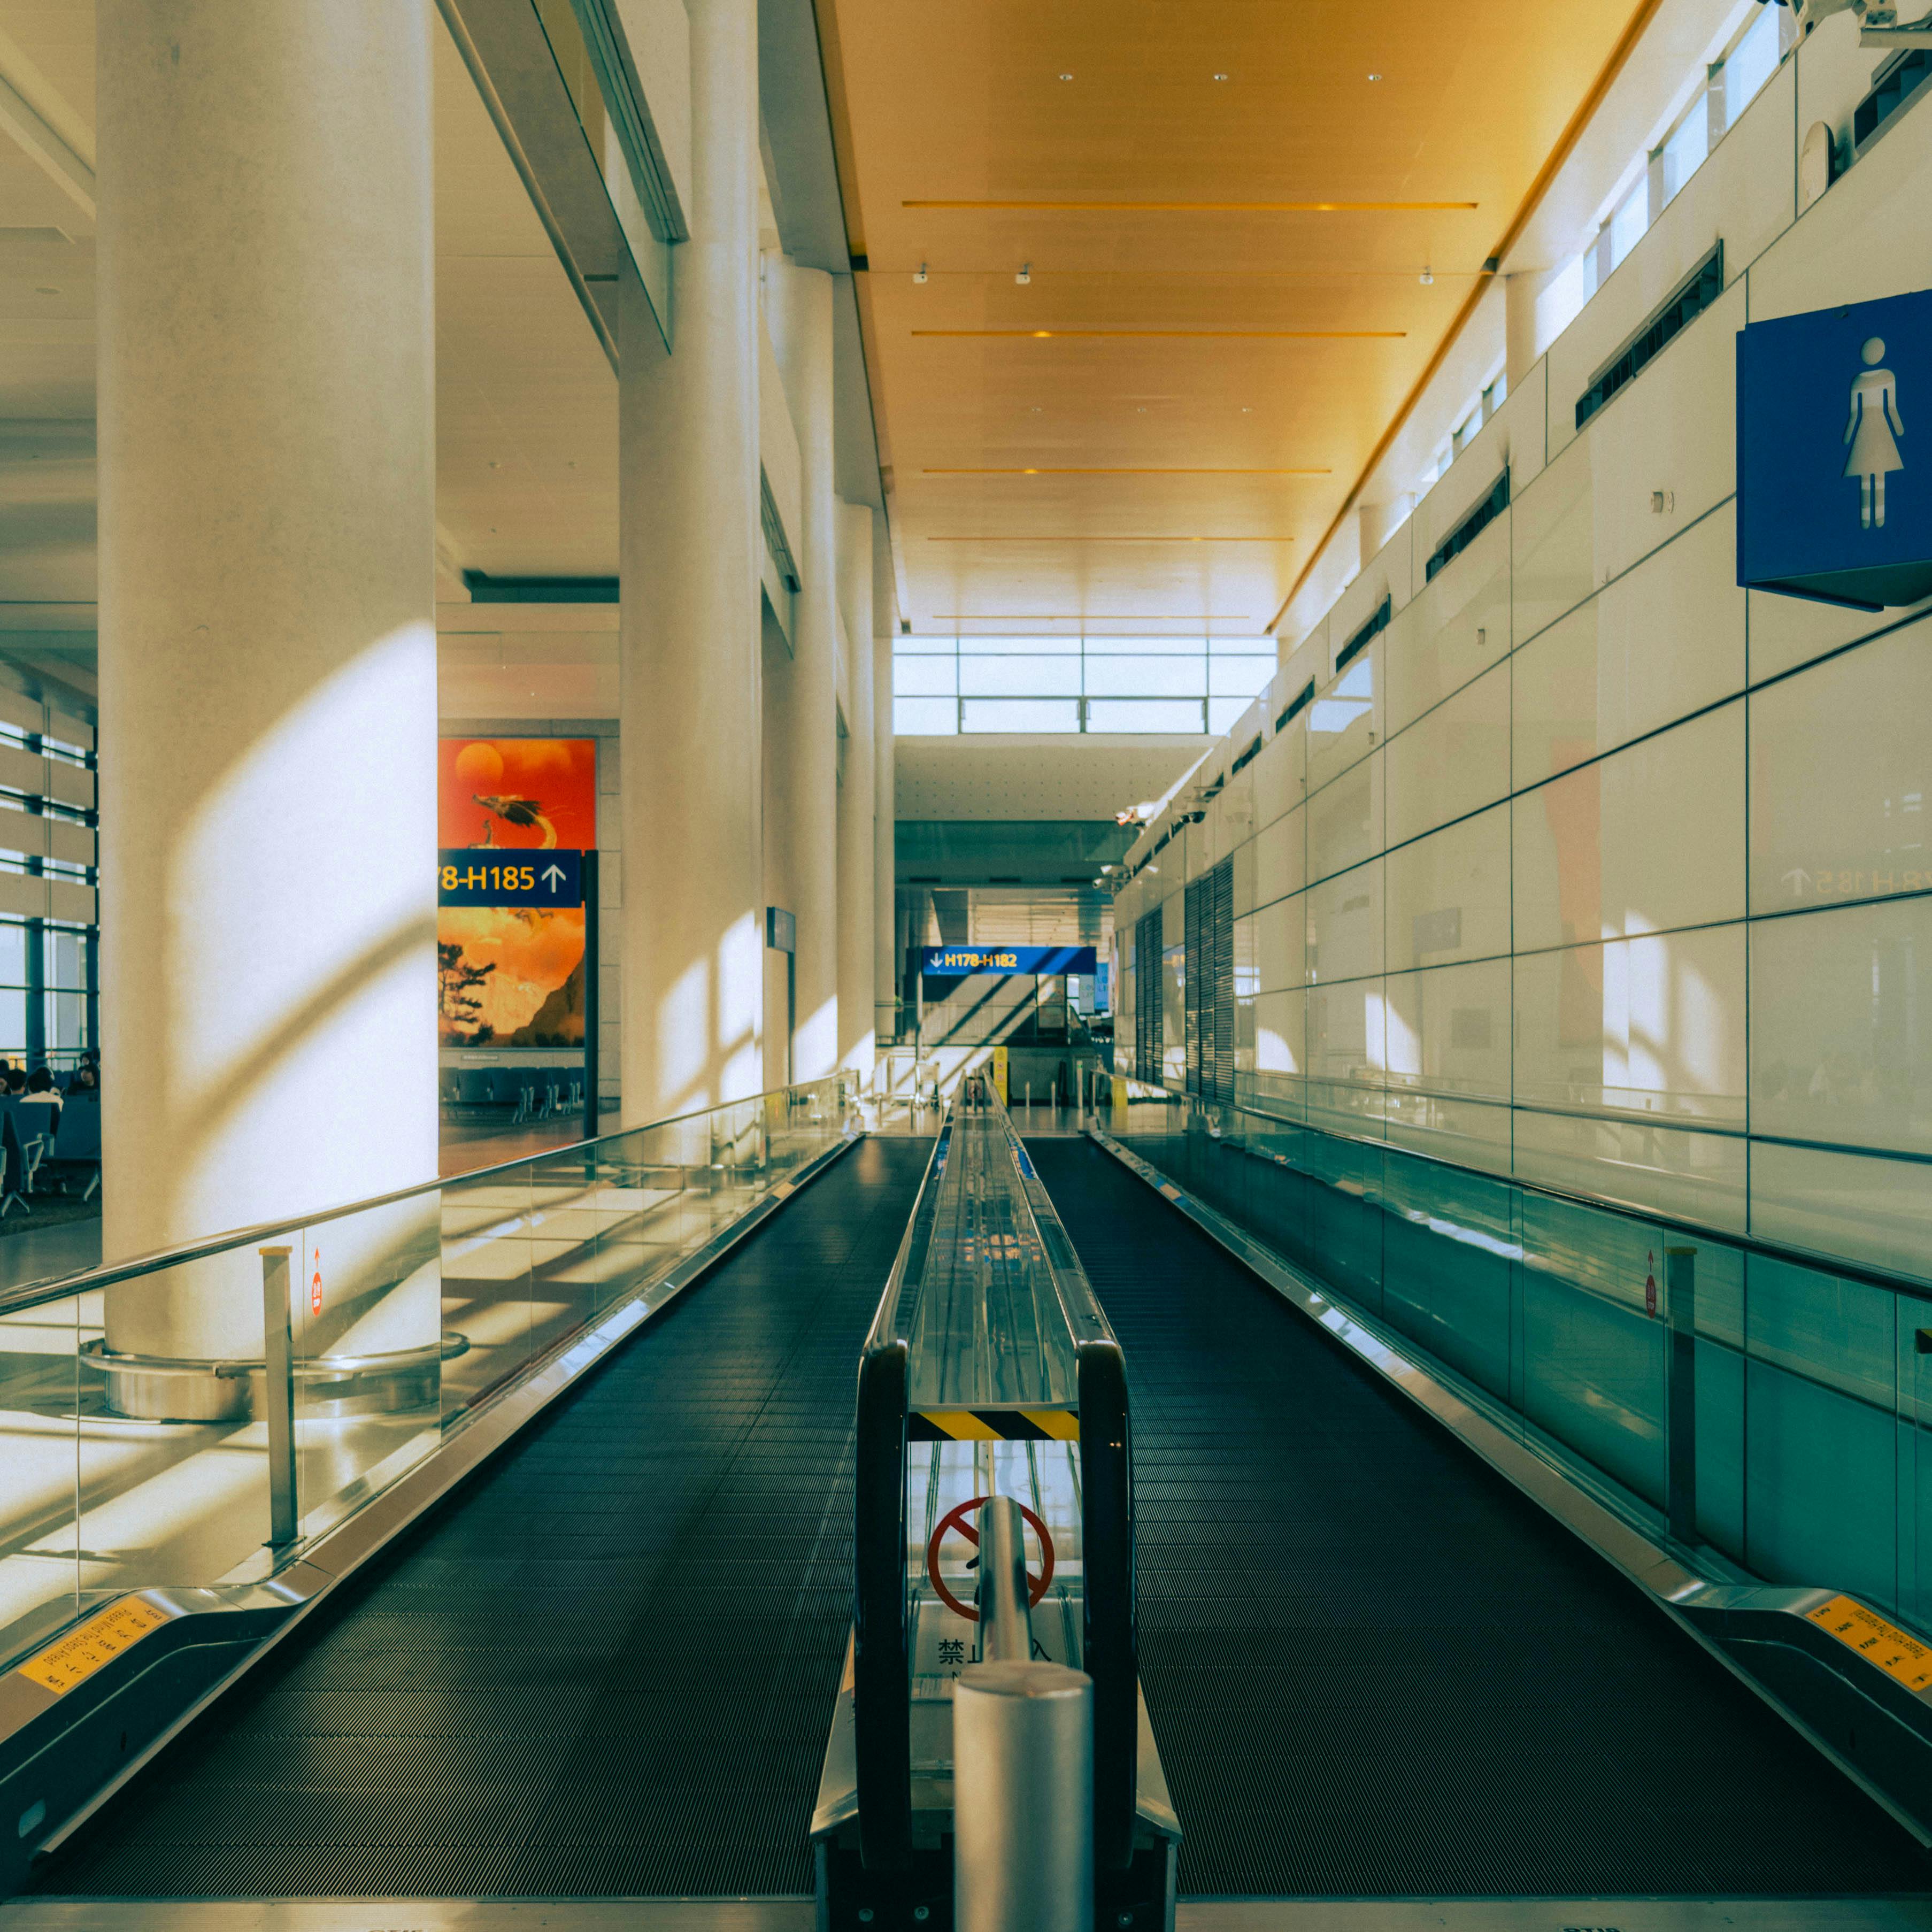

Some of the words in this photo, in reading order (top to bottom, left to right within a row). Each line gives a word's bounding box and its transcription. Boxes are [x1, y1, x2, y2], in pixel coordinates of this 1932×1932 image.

[438, 865, 535, 890] 8-H185
[944, 953, 1018, 967] H178-H182
[106, 1608, 133, 1624] Please
[43, 1649, 71, 1666] Ahead
